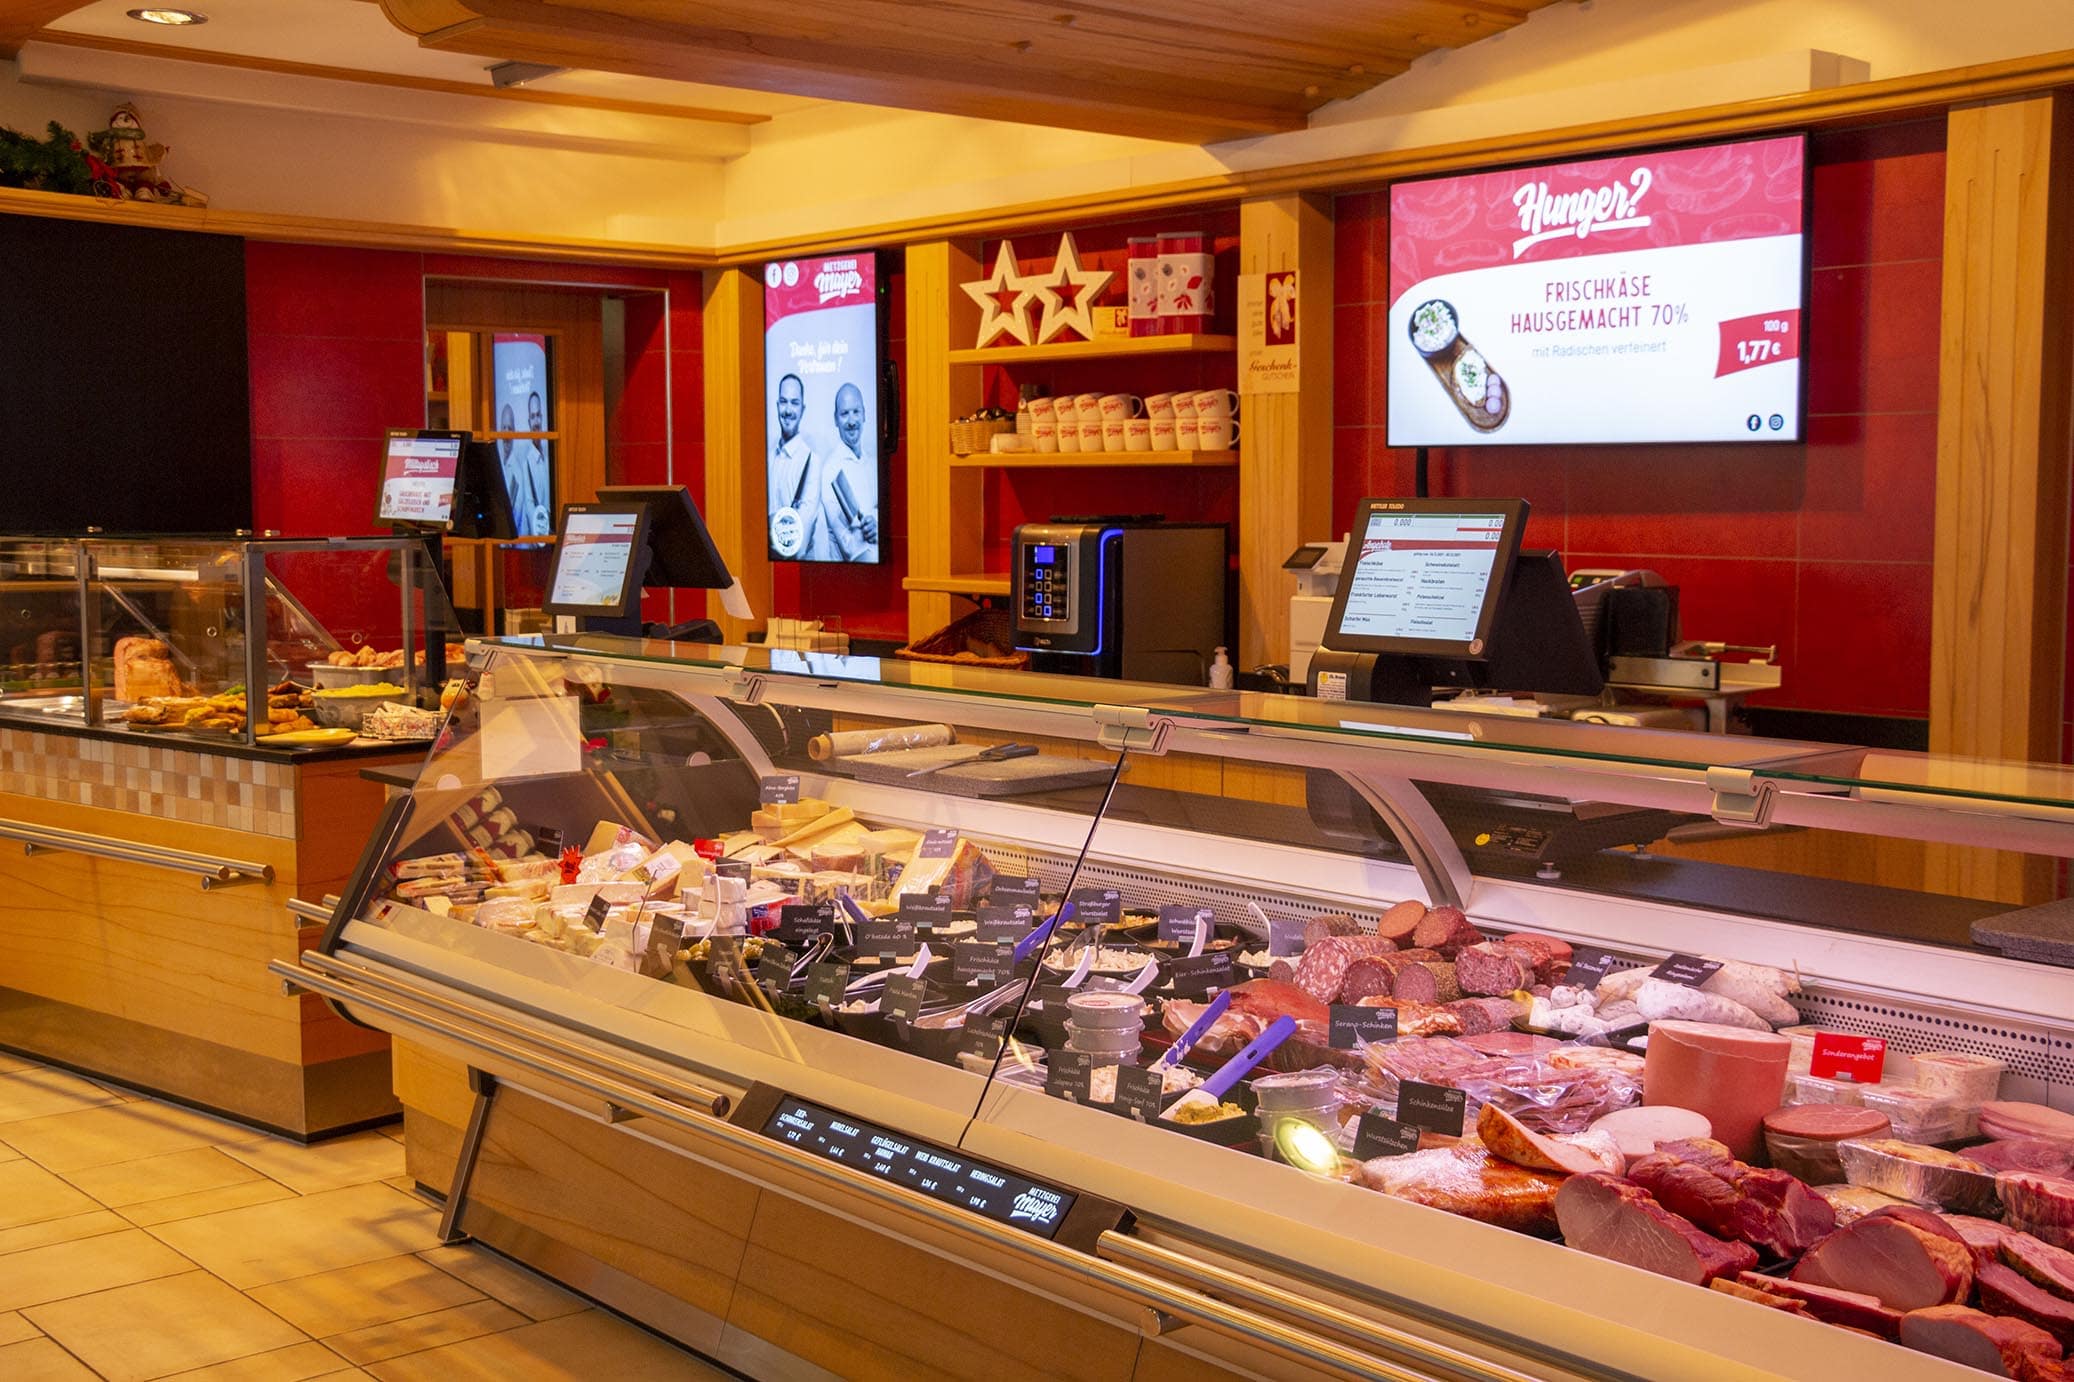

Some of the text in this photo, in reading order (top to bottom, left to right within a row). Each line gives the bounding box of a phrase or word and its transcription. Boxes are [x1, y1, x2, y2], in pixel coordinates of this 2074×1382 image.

[1512, 167, 1653, 240] Hunger?
[813, 270, 863, 299] Mayer
[1545, 271, 1651, 303] FRISCHKÄSE
[1510, 302, 1690, 334] HAUSGEMACHT 70%
[1531, 344, 1550, 358] mit
[1552, 342, 1611, 357] Radischen
[984, 918, 1026, 927] Weißkrautsalat
[1822, 1048, 1876, 1062] Sonderangebot
[1013, 1192, 1058, 1222] Mayer
[1028, 1186, 1062, 1204] METZGEREI
